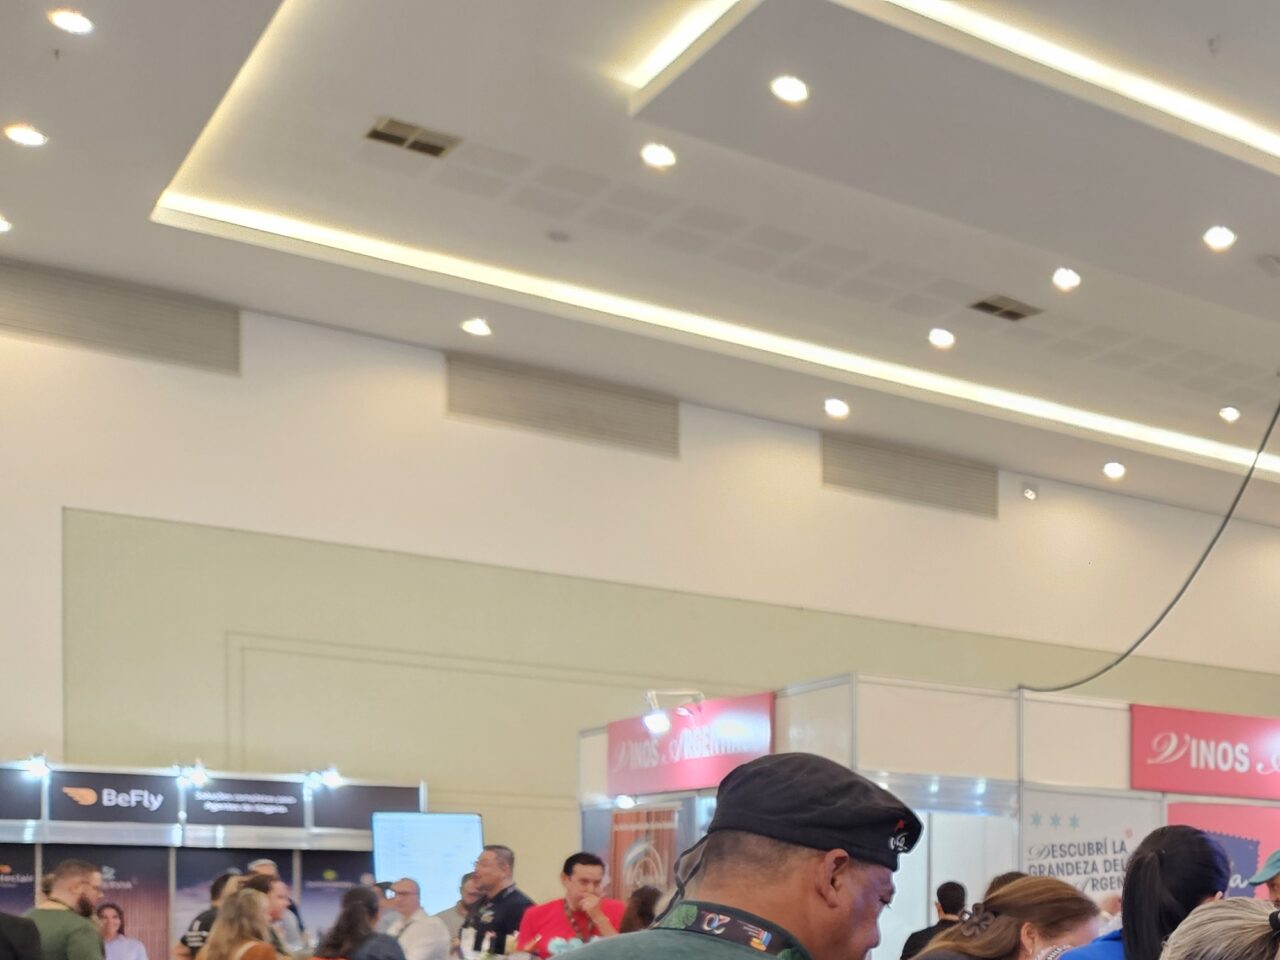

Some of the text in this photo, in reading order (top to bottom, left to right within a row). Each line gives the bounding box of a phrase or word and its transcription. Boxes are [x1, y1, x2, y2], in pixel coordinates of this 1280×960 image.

[1147, 731, 1250, 773] VINOS
[102, 788, 154, 812] BeFly
[1028, 837, 1128, 860] DESCUBRÍ LA
[1028, 859, 1099, 878] GRANDEZA
